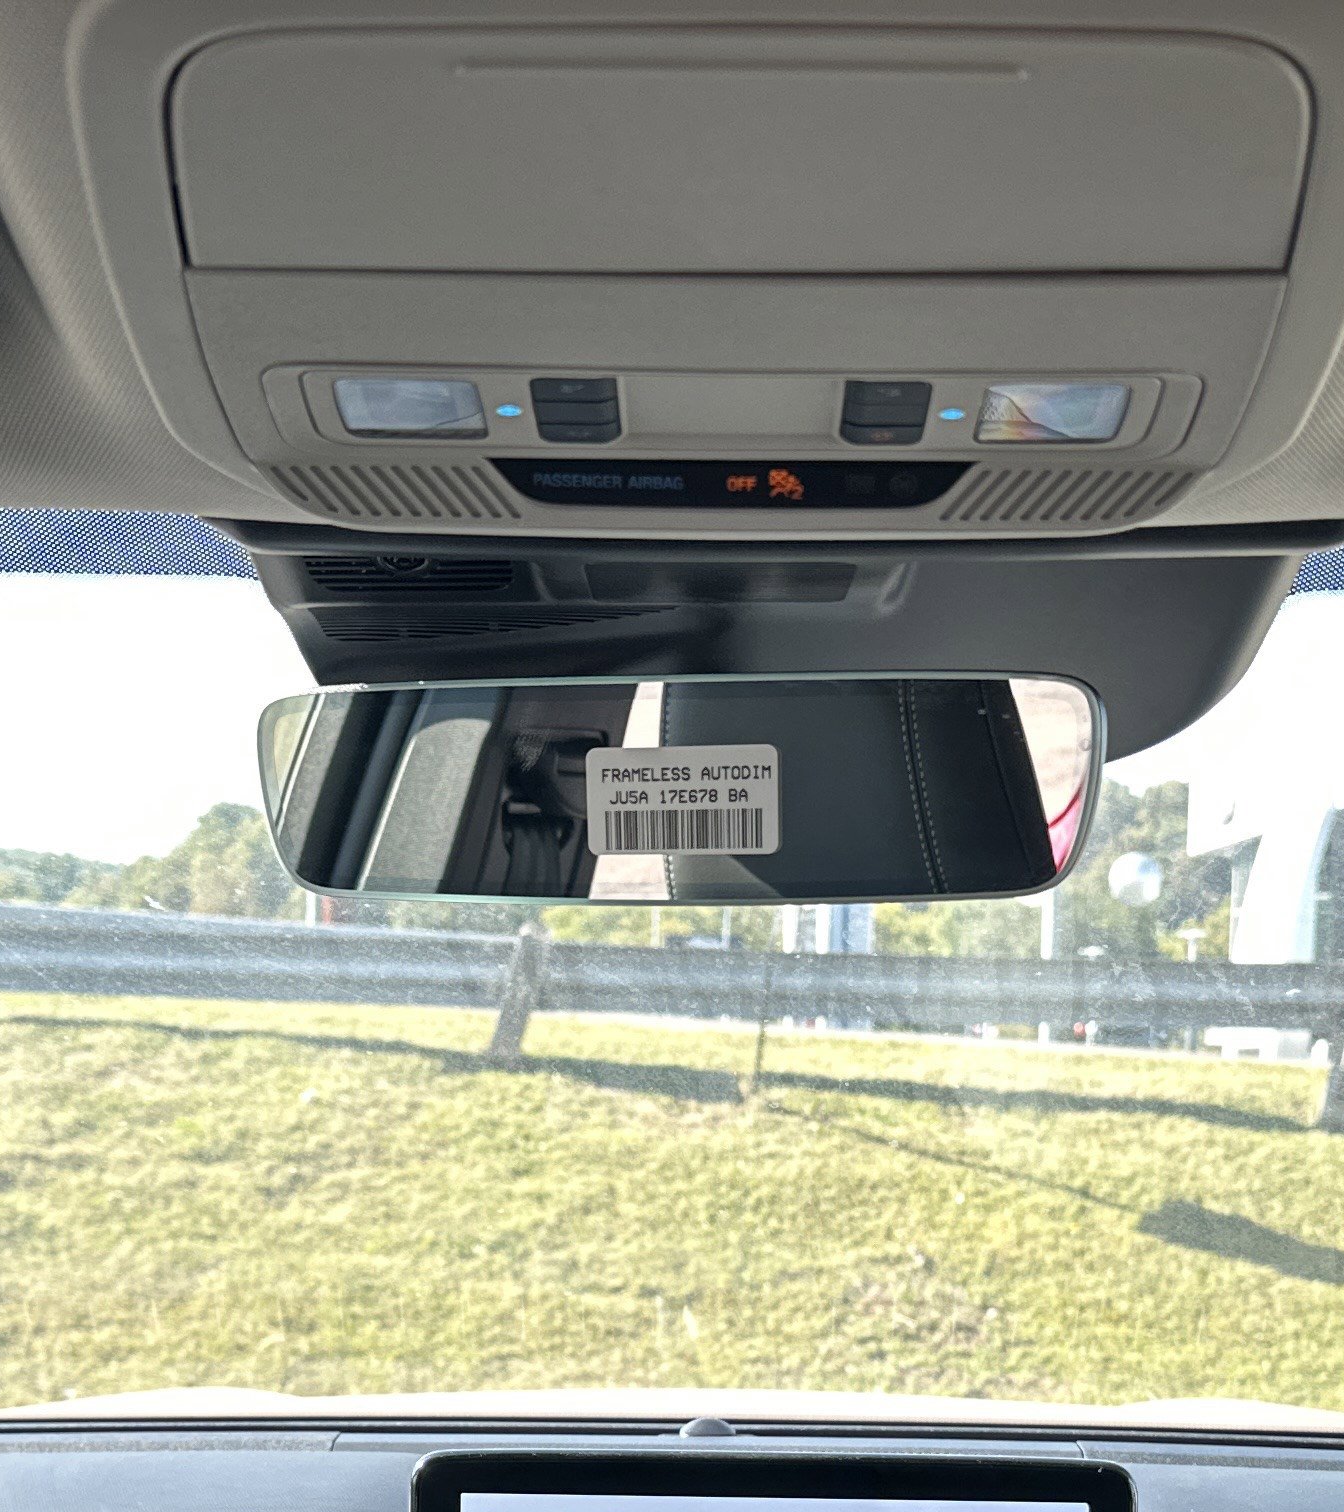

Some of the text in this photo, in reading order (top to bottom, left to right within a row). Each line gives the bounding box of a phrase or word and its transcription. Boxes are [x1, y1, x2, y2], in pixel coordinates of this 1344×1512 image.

[532, 473, 683, 491] PASSENGER AIRBAG
[726, 476, 756, 492] OFF
[601, 765, 771, 783] FRAMELESS AUTODIM
[660, 789, 718, 804] 17E678
[728, 788, 748, 802] BA
